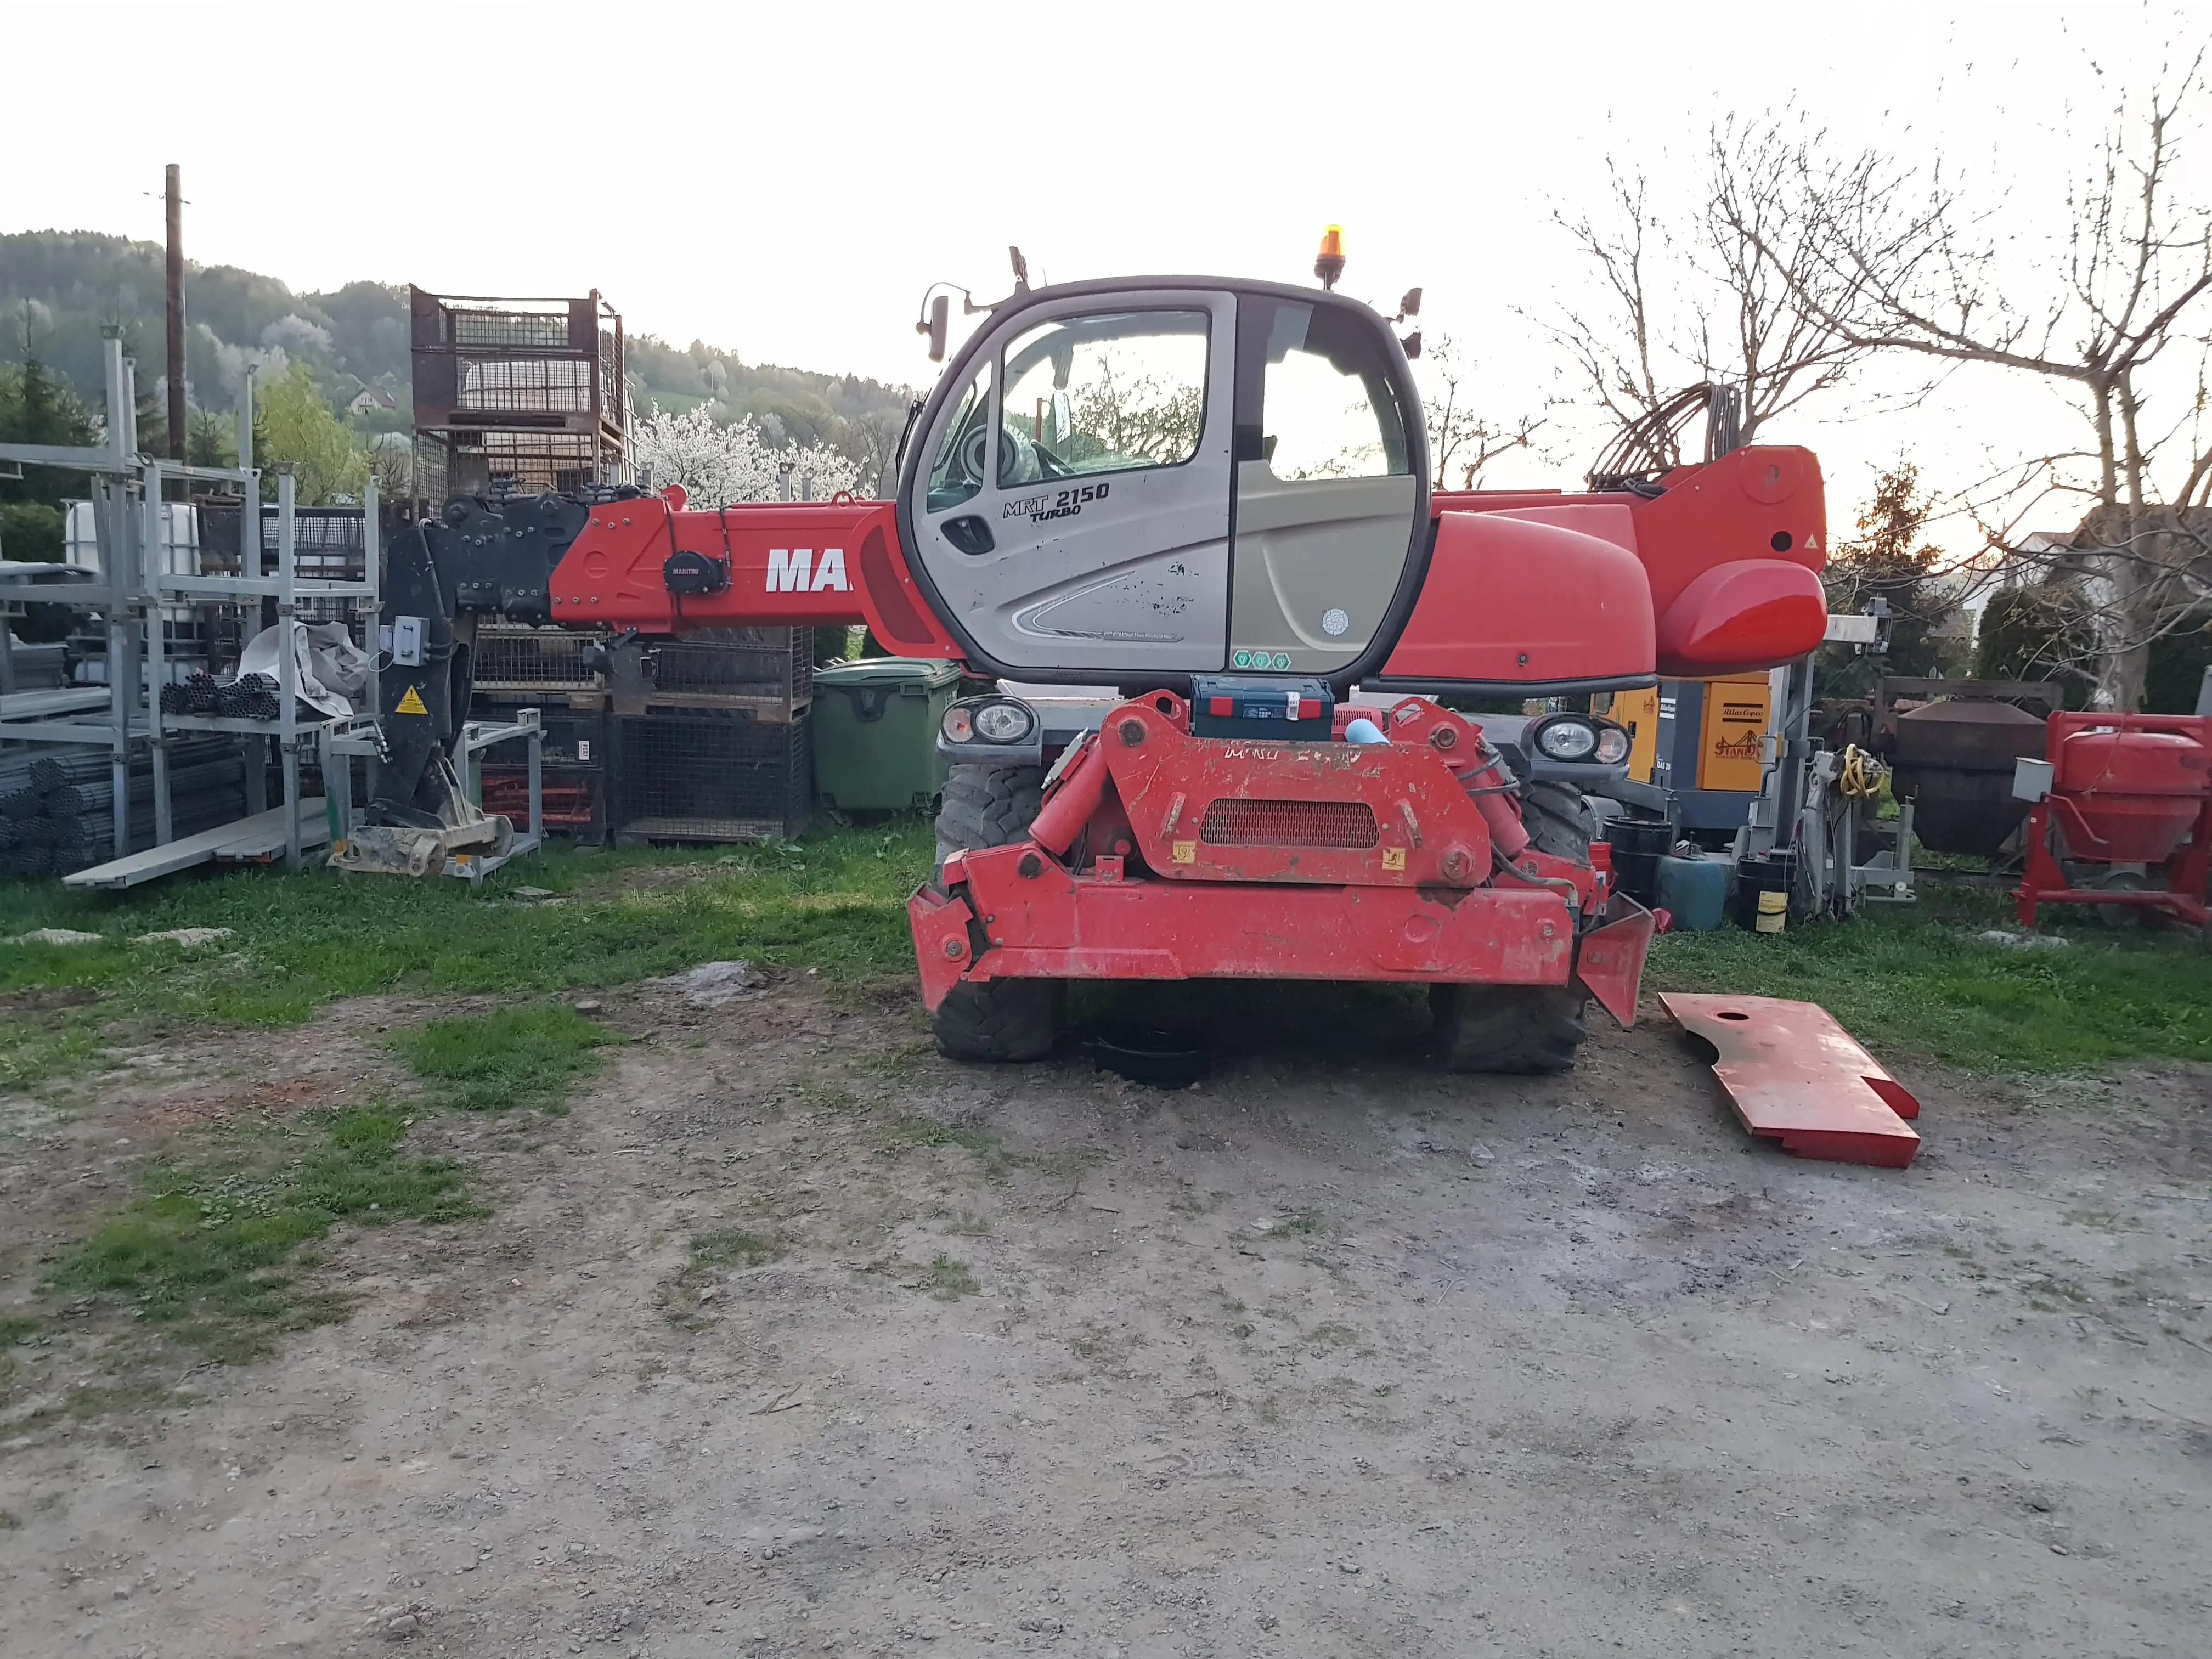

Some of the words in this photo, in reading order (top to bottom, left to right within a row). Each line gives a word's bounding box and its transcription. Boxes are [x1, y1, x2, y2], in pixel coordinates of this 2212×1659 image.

[1003, 495, 1049, 518] MRT
[1057, 482, 1109, 508] 2150
[1030, 505, 1081, 522] TURBO
[766, 548, 854, 592] MA
